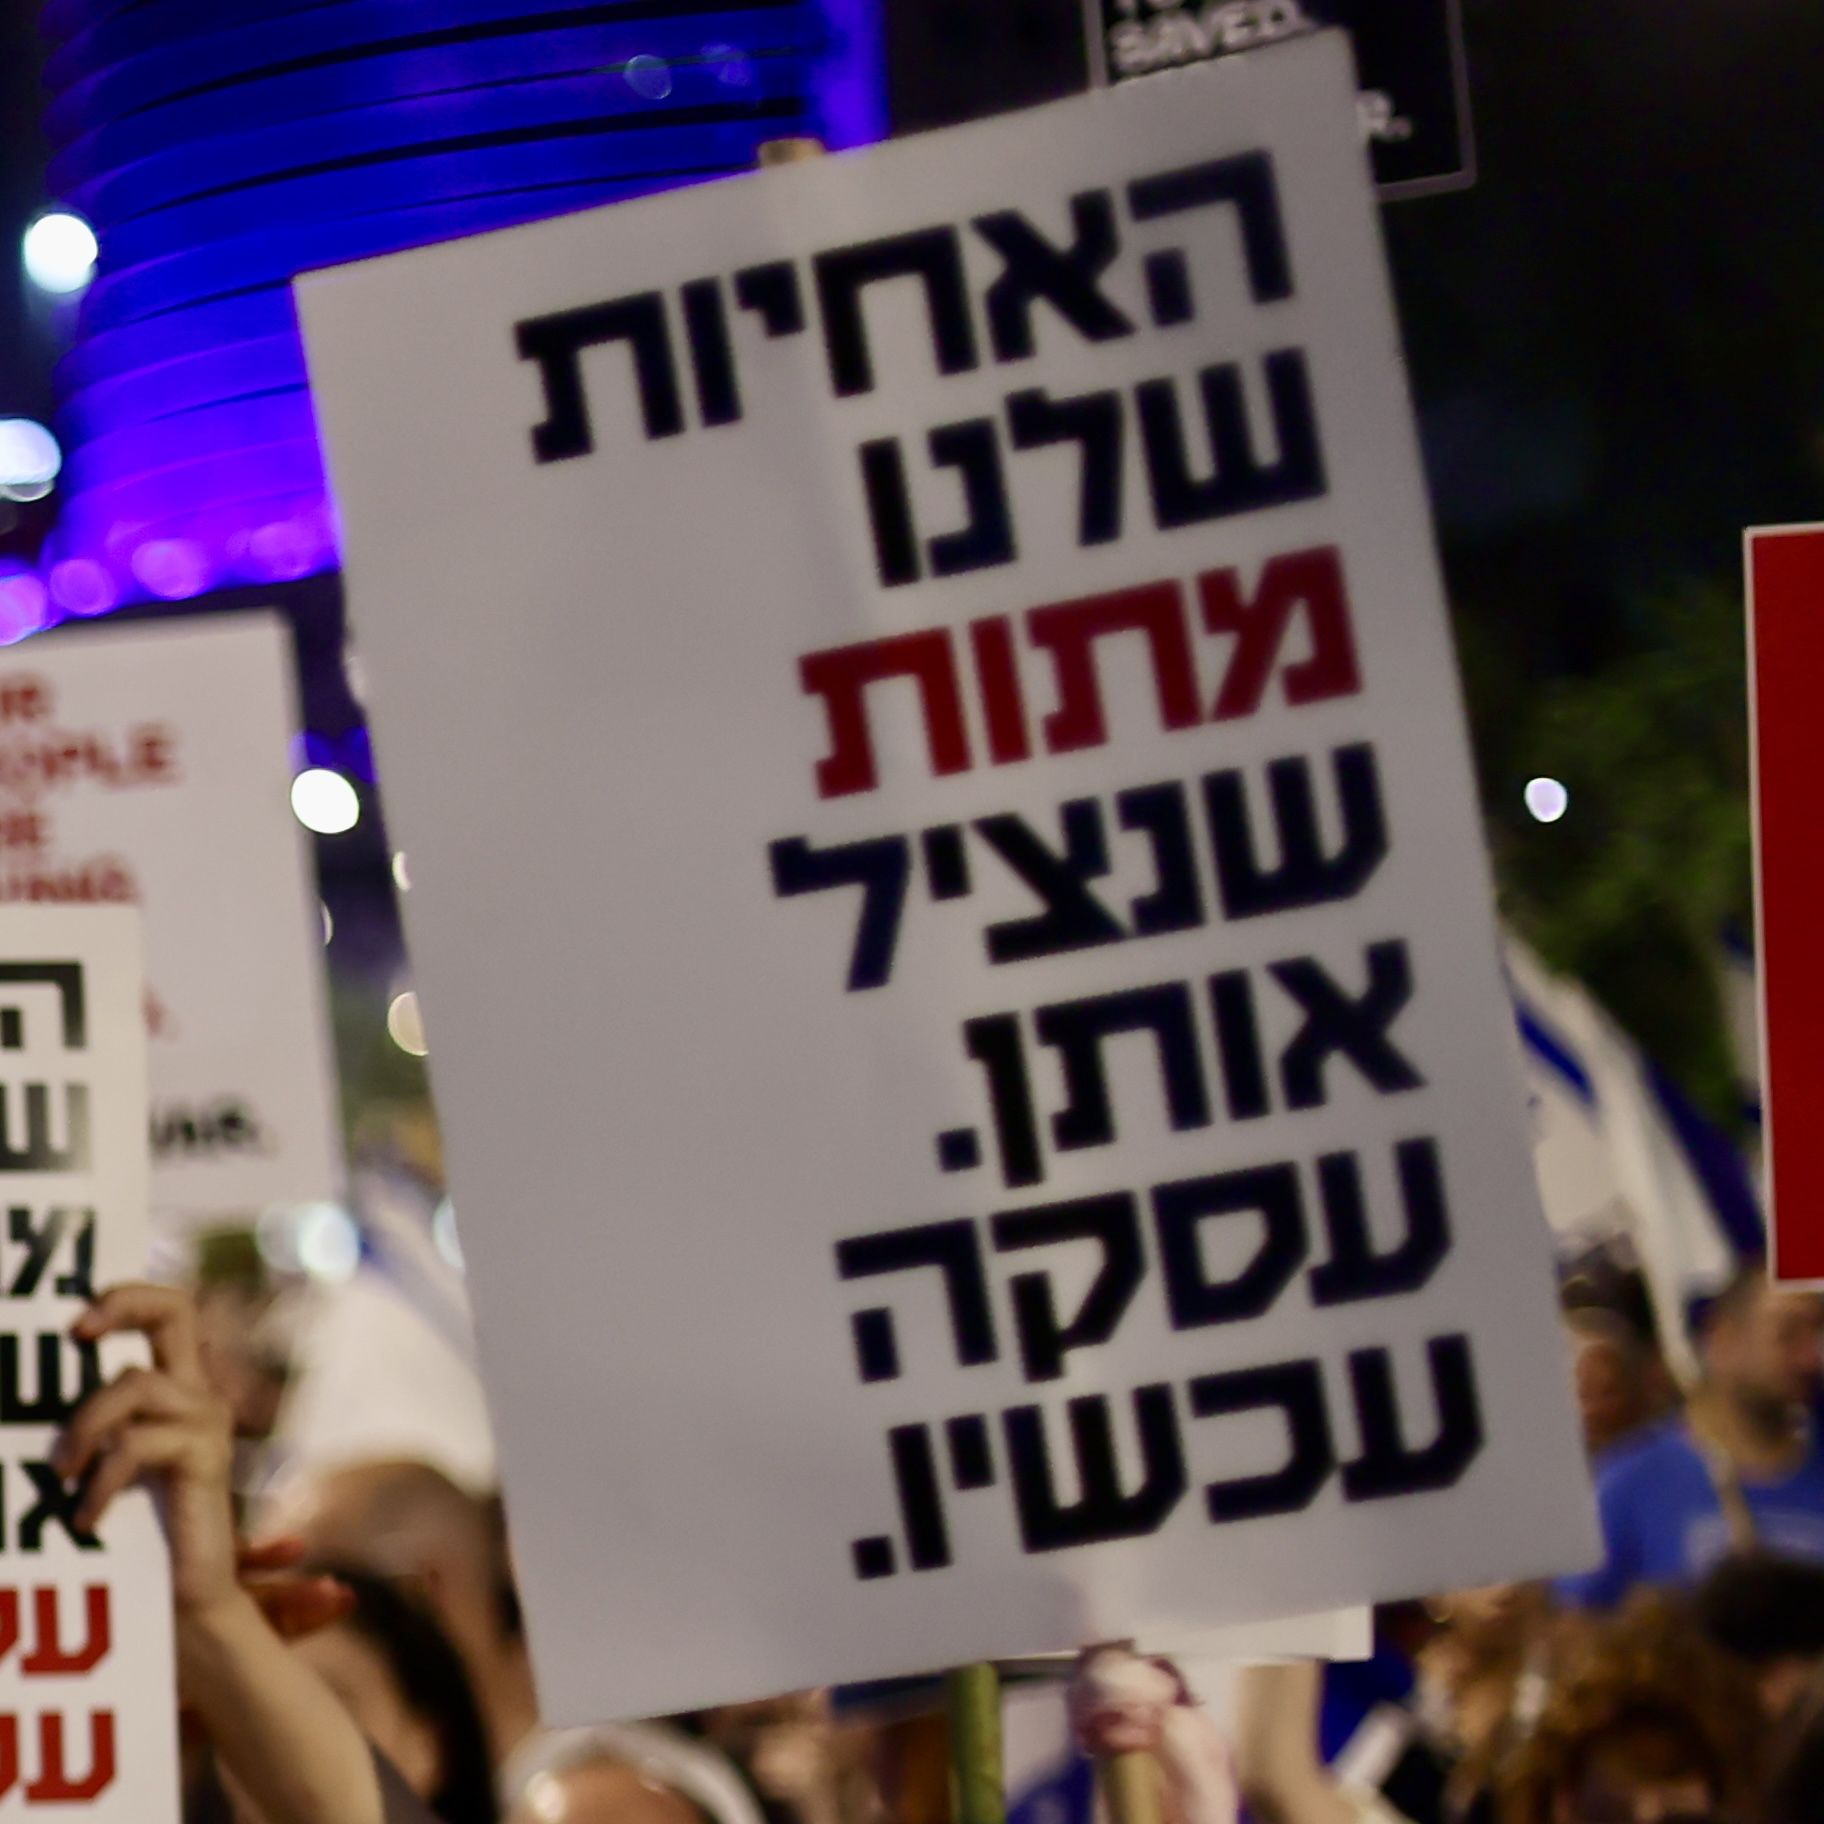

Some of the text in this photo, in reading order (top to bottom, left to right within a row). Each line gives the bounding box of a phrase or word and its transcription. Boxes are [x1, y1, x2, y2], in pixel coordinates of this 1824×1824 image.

[515, 149, 1296, 463] האחיות
[860, 347, 1328, 587] שלנו
[799, 545, 1361, 798] מתות
[769, 743, 1388, 991] שנציל
[938, 939, 1424, 1188] אותן.
[836, 1136, 1452, 1382] עסקה
[852, 1333, 1485, 1580] עכשיו.
